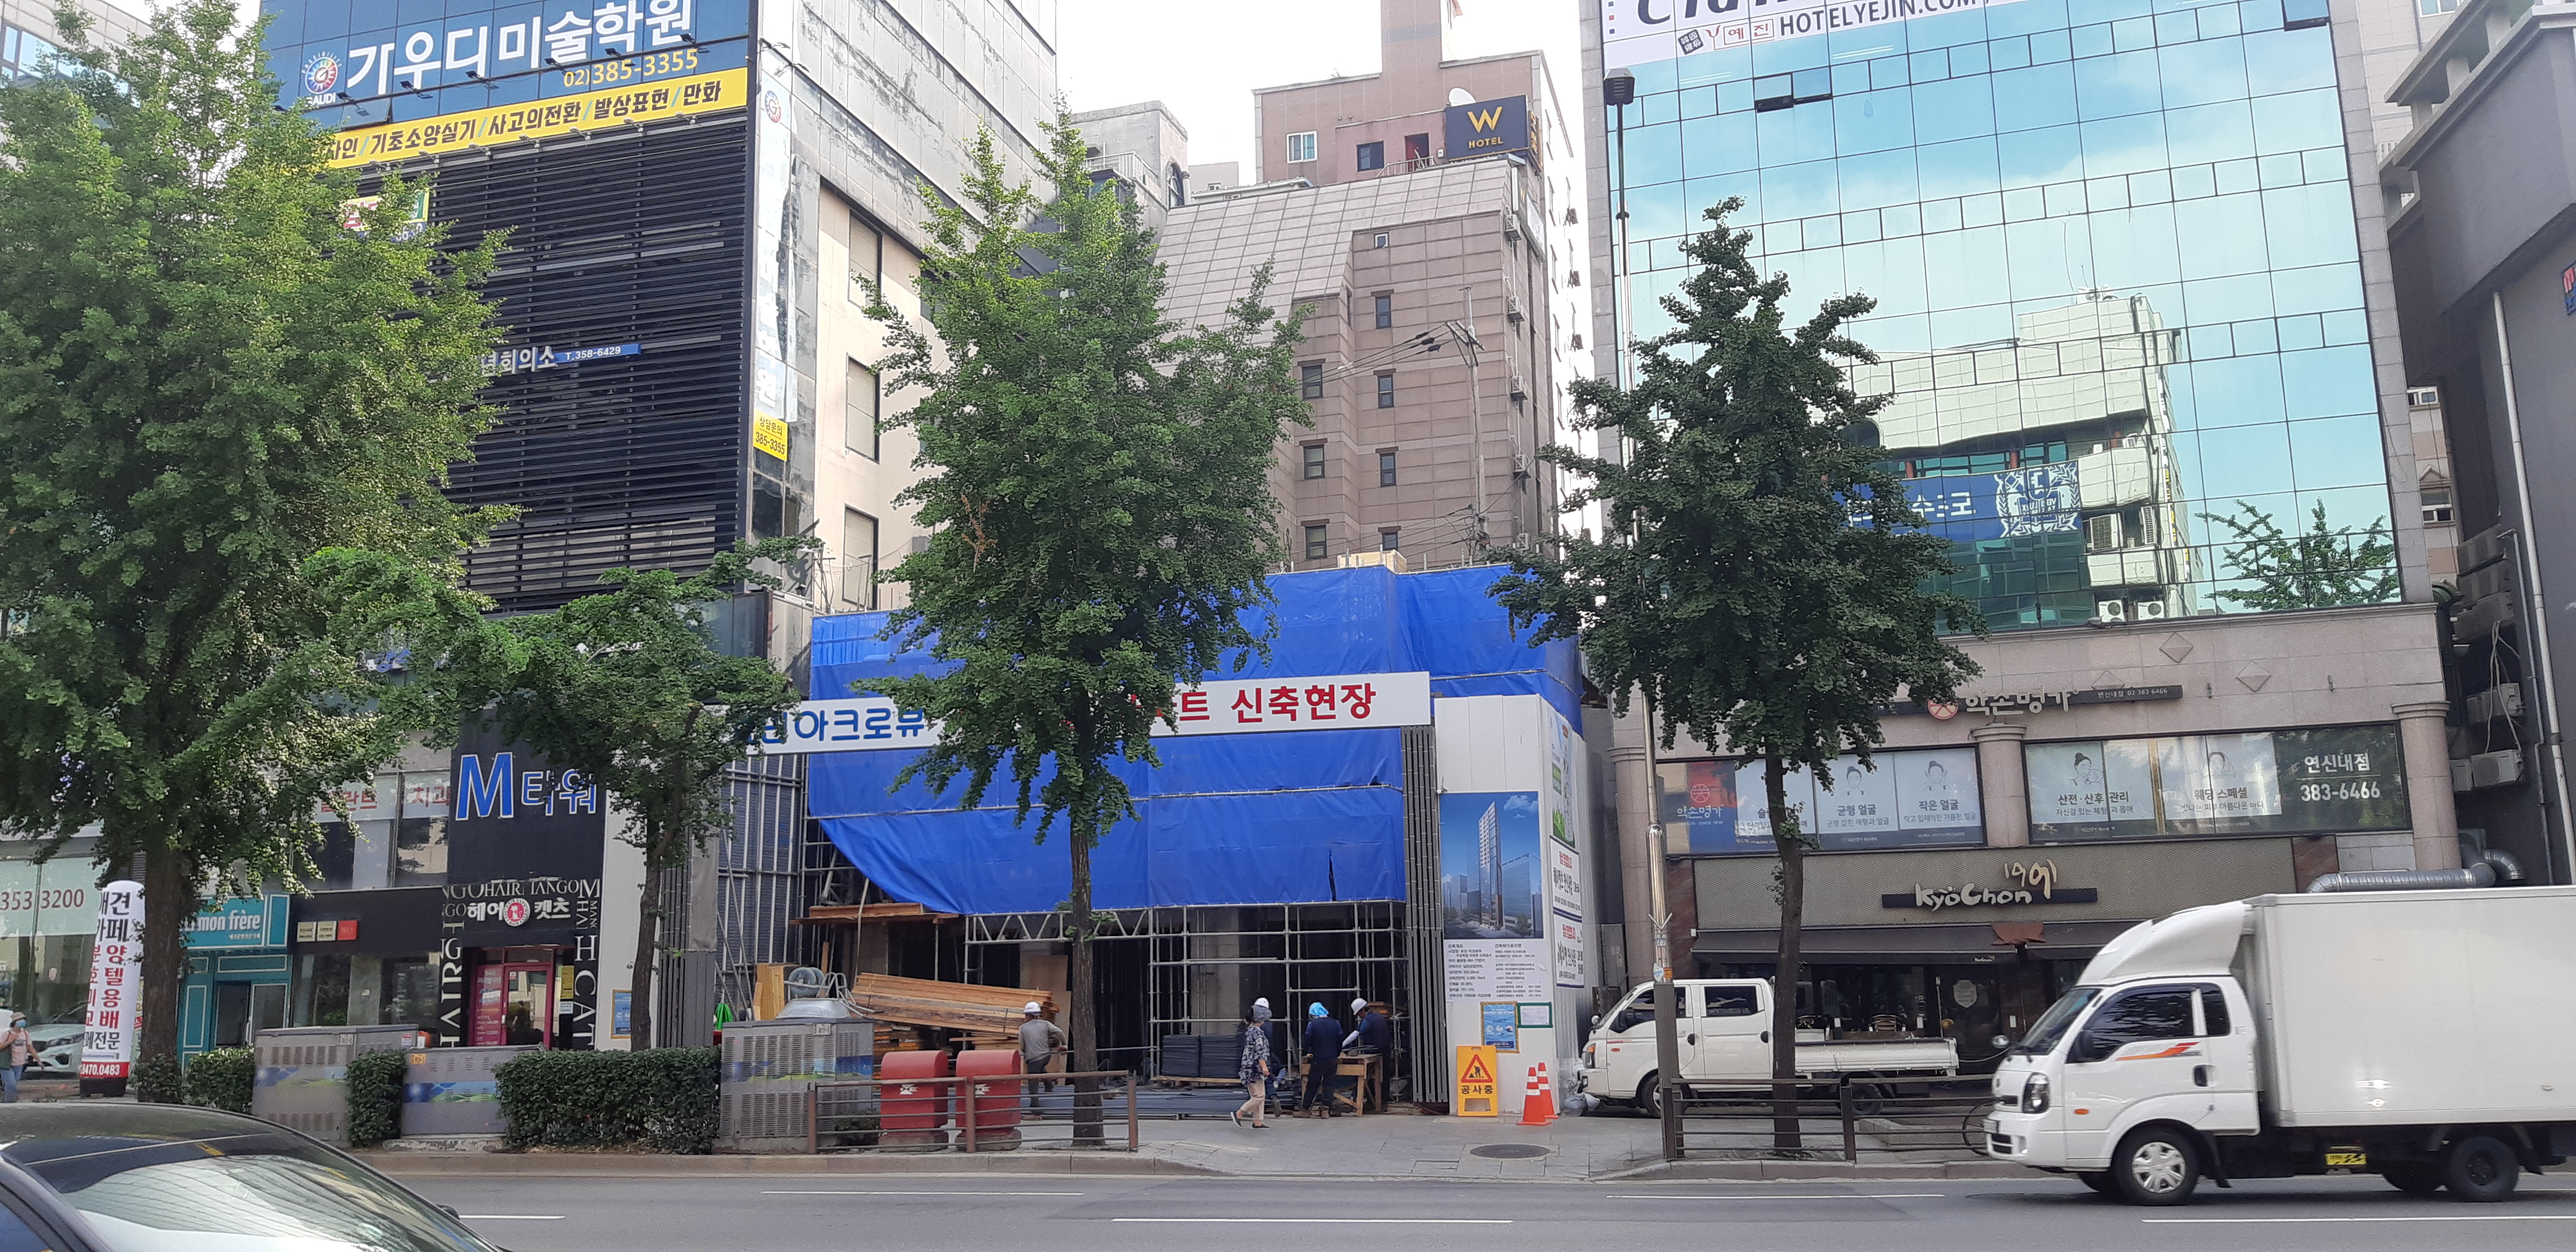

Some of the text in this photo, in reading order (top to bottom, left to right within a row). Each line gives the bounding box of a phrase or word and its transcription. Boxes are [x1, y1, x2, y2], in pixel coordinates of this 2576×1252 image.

[347, 0, 693, 95] 가우디미술학원
[683, 80, 721, 106] 만화
[1467, 106, 1503, 133] W
[1469, 136, 1504, 149] HOTEL
[565, 346, 622, 361] T.358-6429
[759, 416, 783, 437] 상담문의
[755, 431, 785, 455] 385-3355
[1231, 682, 1376, 723] 신축현장
[1965, 685, 2071, 717] 약손명가
[2304, 752, 2370, 774] 연신내점
[456, 752, 514, 821] M
[2109, 791, 2129, 803] 관리
[2300, 781, 2381, 802] 383-6466
[1858, 804, 1877, 815] 얼굴
[1918, 799, 1959, 812] 작은 얼굴
[41, 889, 84, 908] 3200
[467, 900, 504, 922] 헤어
[197, 915, 225, 932] mon
[1460, 1085, 1494, 1094] 공사중
